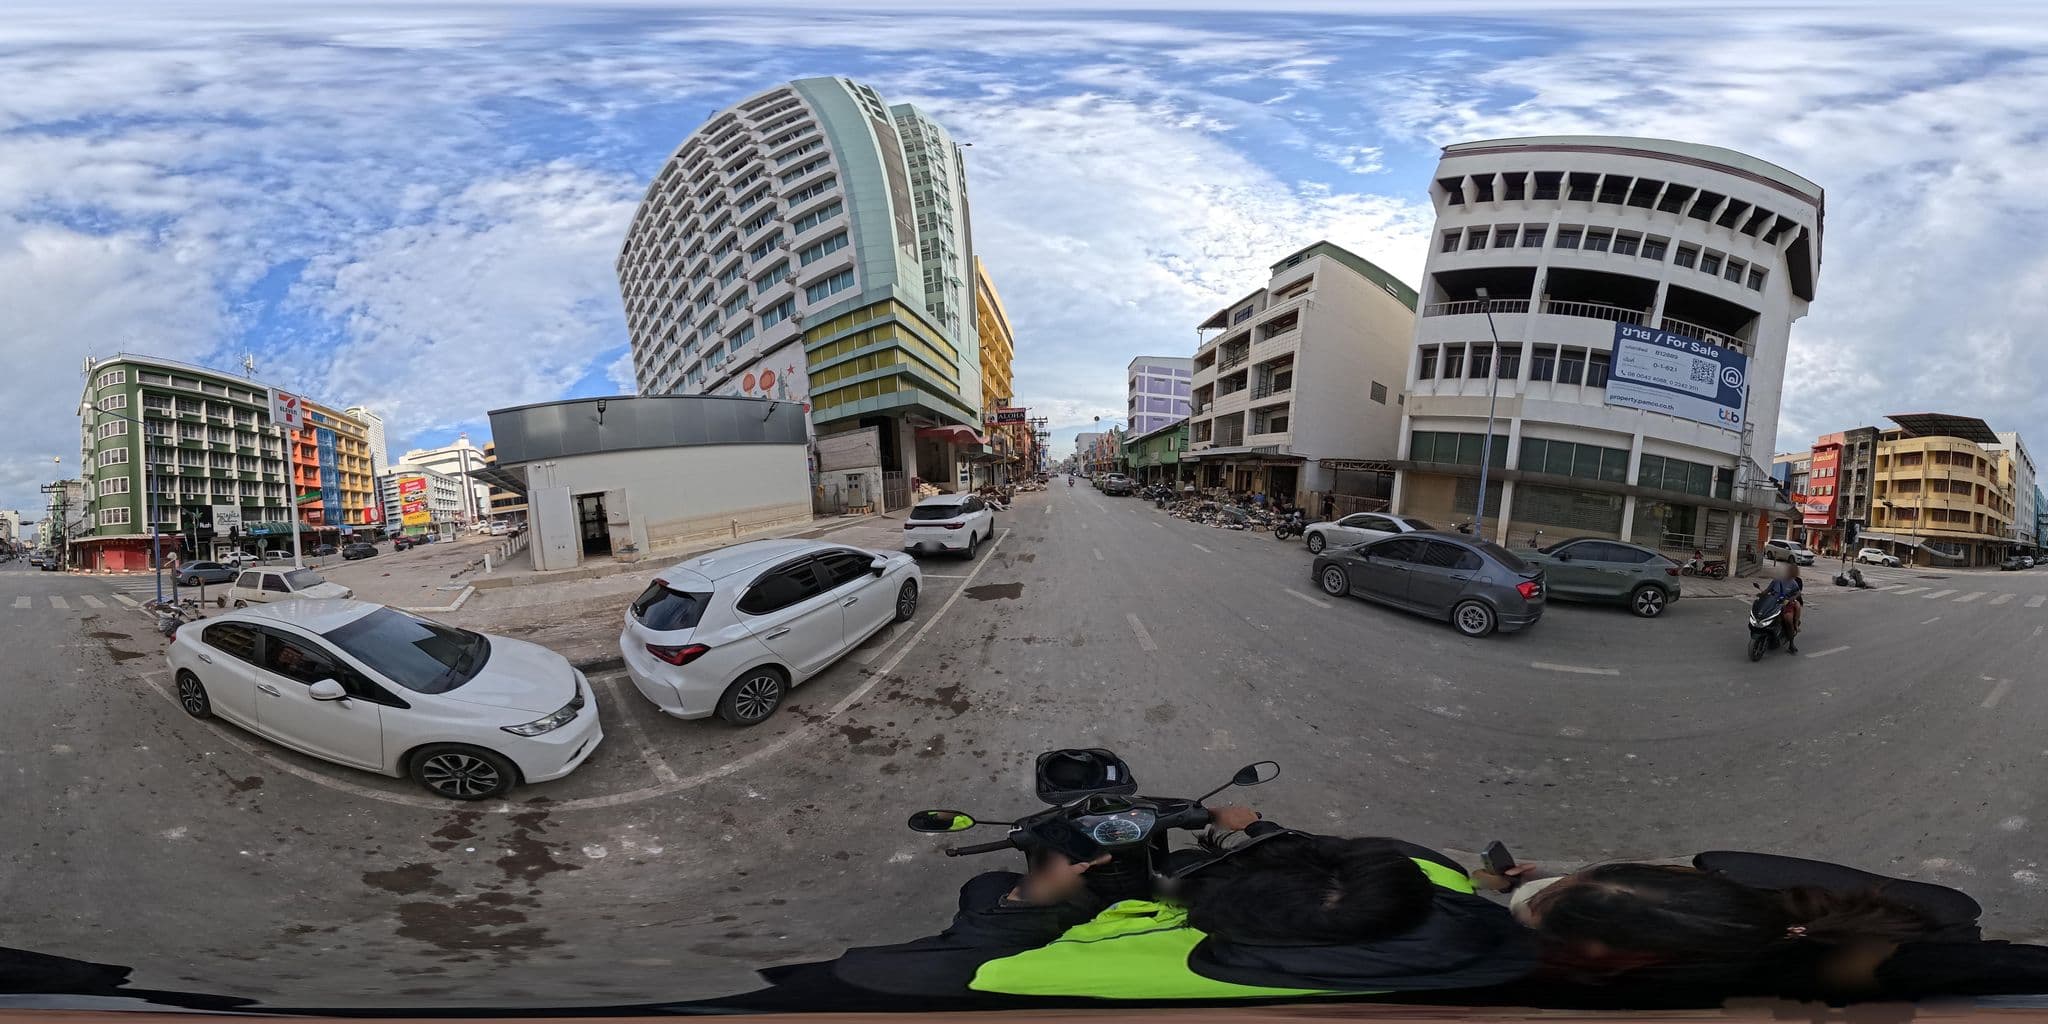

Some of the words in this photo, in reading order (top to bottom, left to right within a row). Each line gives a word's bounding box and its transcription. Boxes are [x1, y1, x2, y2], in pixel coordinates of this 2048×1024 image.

[1622, 327, 1651, 340] ขาย
[1654, 333, 1663, 343] /
[1666, 335, 1688, 349] For
[1690, 342, 1719, 358] Sale
[1719, 408, 1740, 423] ttb
